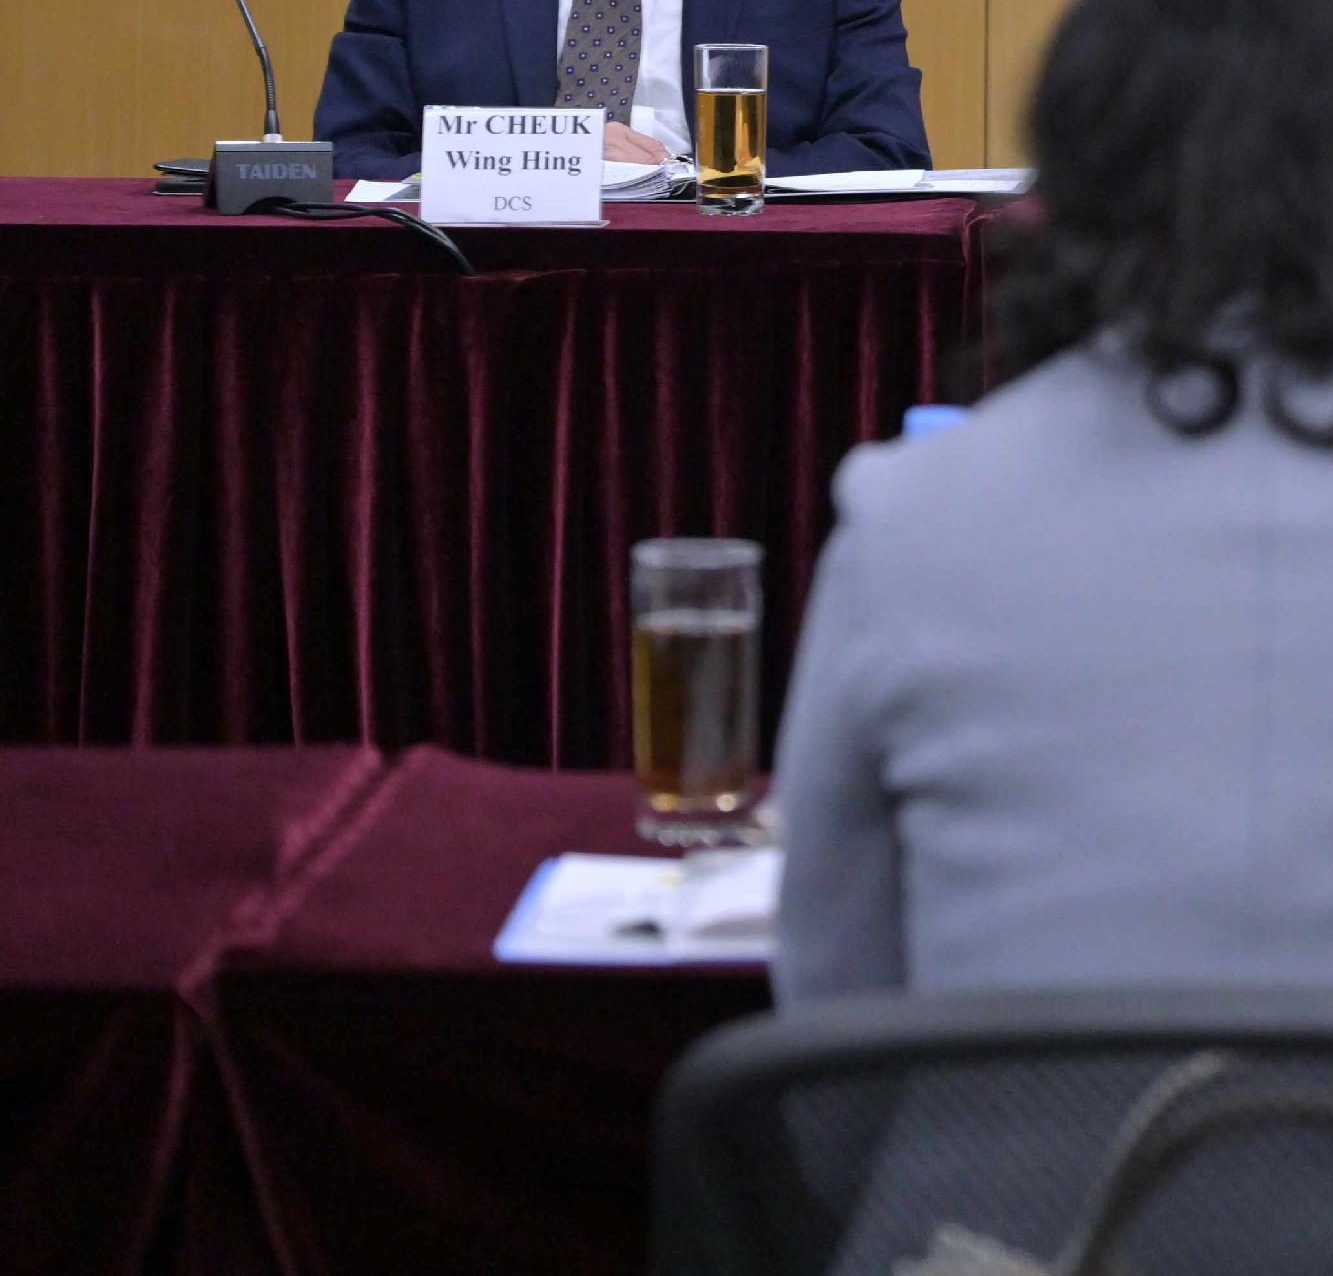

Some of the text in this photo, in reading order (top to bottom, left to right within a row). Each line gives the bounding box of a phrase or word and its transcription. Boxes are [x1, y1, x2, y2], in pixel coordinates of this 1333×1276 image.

[437, 114, 591, 135] Mr CHEUK
[235, 164, 319, 179] TAIDEN
[446, 150, 582, 176] Wing Hing
[494, 196, 532, 212] DCS
